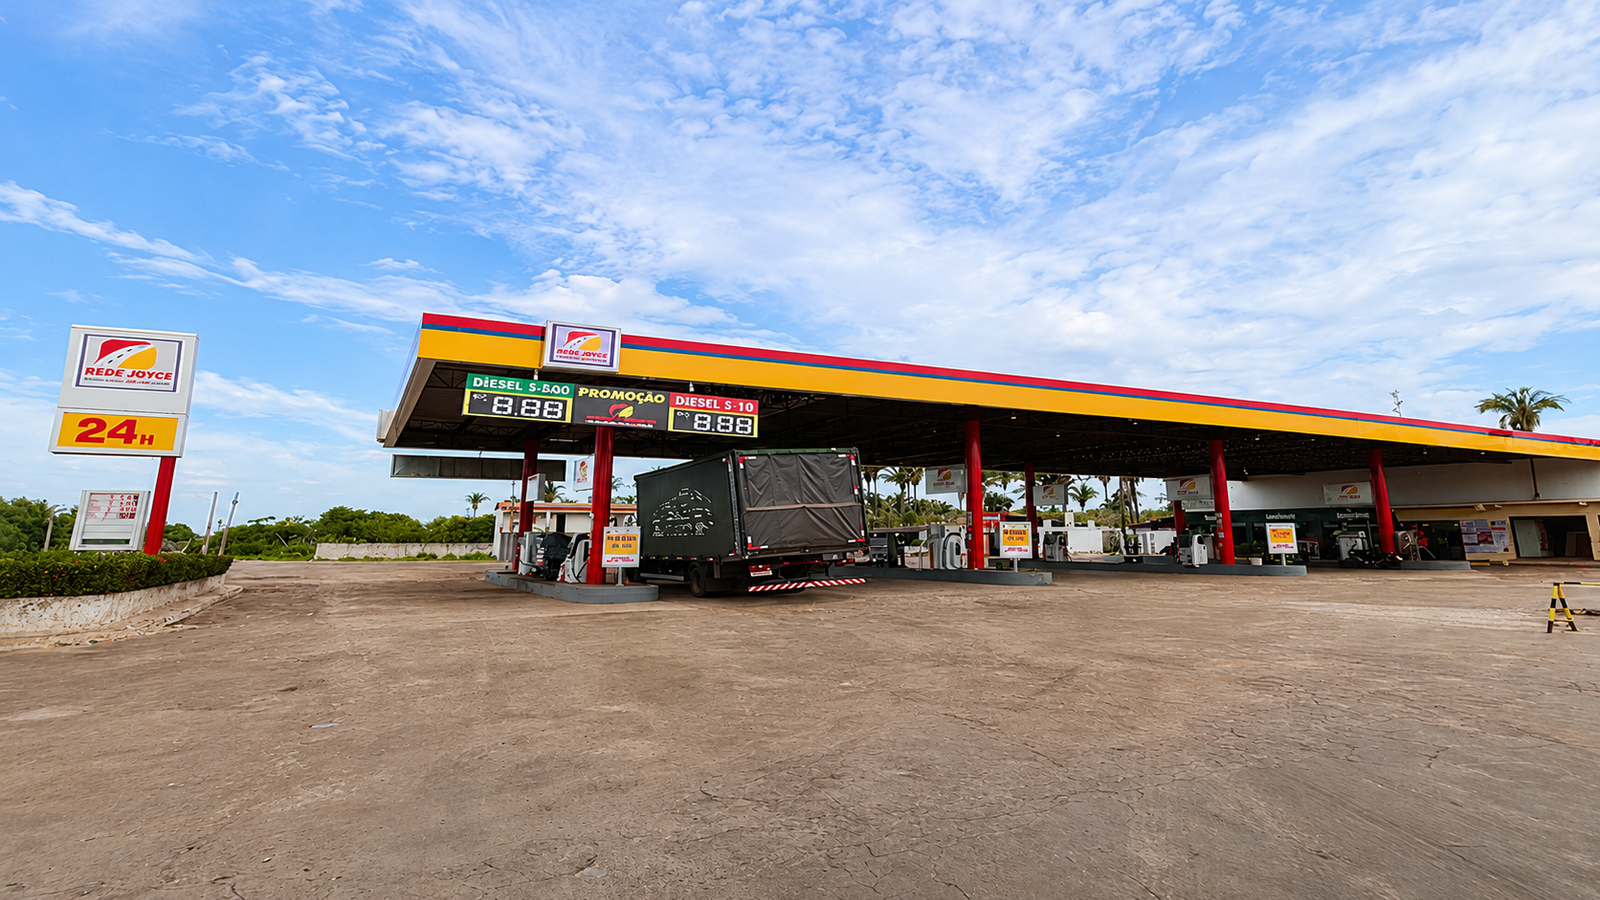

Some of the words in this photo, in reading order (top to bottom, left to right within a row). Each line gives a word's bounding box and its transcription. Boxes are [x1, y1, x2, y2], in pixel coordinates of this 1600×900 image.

[85, 367, 125, 377] REDE
[126, 370, 173, 380] JOYCE
[578, 387, 666, 404] PROMOÇÃO
[675, 395, 720, 409] DIESEL
[724, 400, 754, 412] S-10
